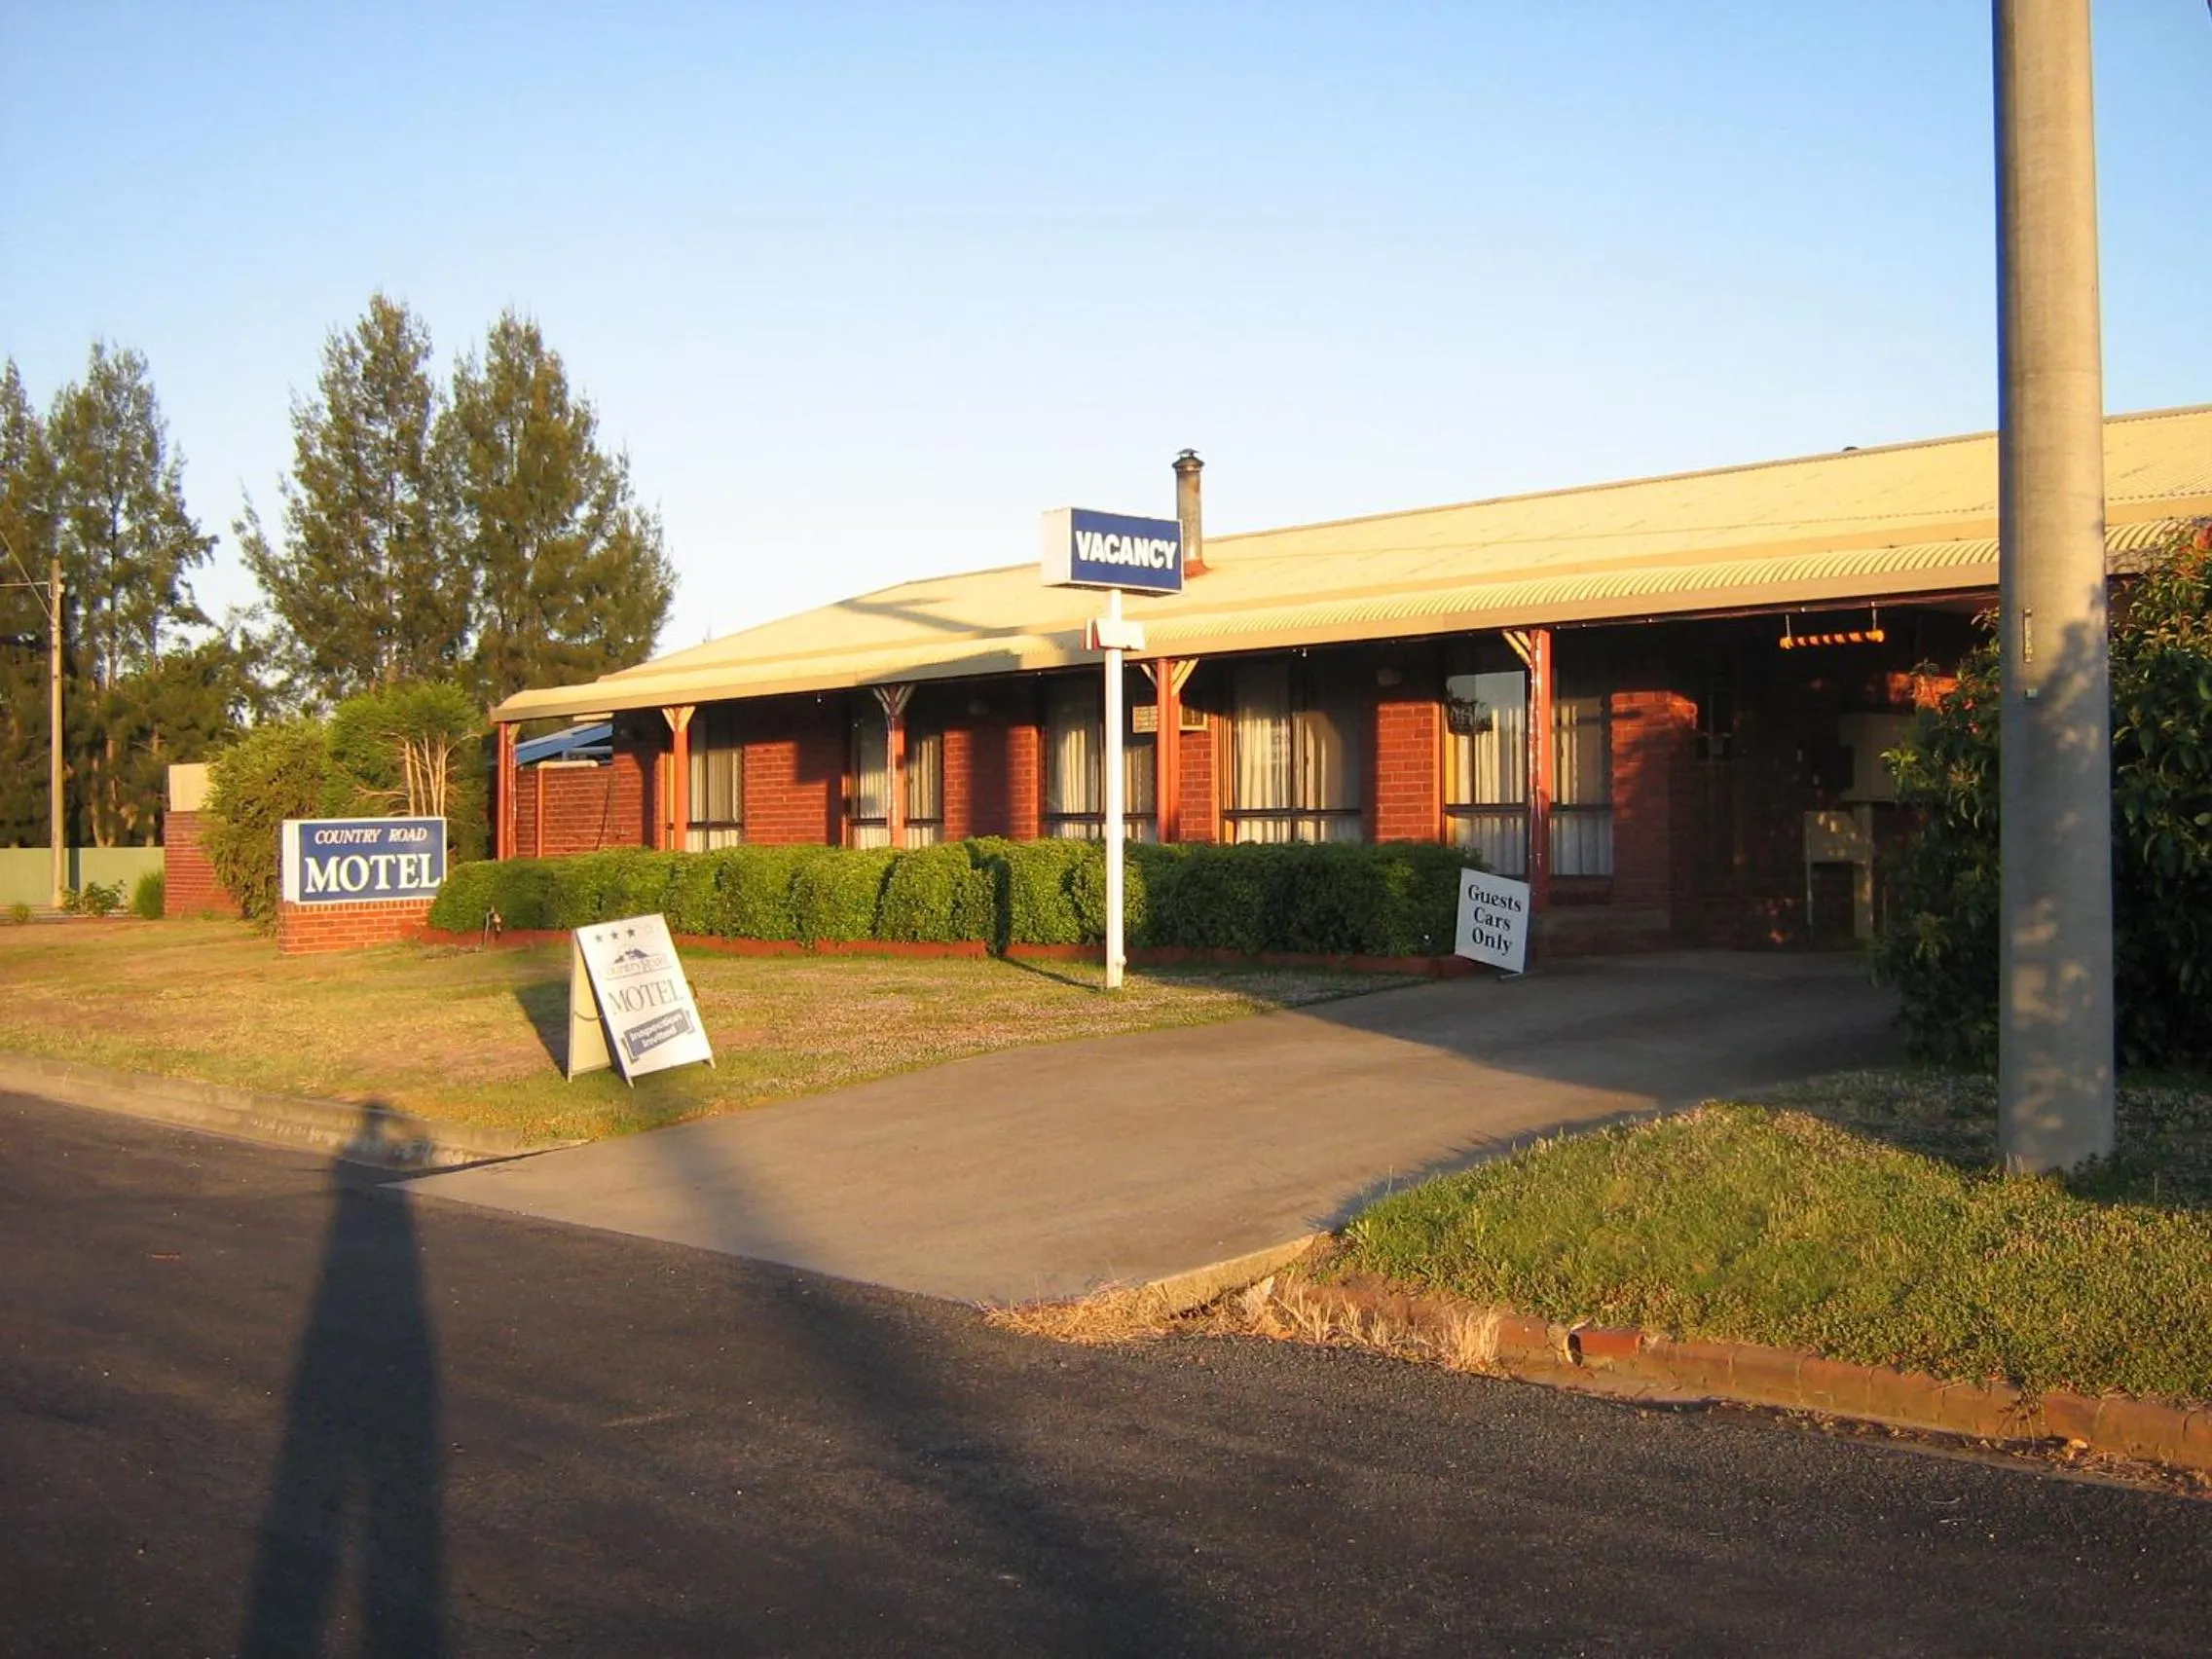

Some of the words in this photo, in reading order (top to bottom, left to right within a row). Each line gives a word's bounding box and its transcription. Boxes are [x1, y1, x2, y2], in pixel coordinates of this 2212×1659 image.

[1075, 530, 1177, 570] VACANCY
[314, 829, 382, 844] COUNTRY
[387, 828, 427, 843] ROAD
[304, 853, 442, 893] MOTEL
[1467, 884, 1522, 912] Guests
[1474, 906, 1511, 932] Cars
[1472, 927, 1513, 956] Only
[608, 978, 683, 1015] MOTEL
